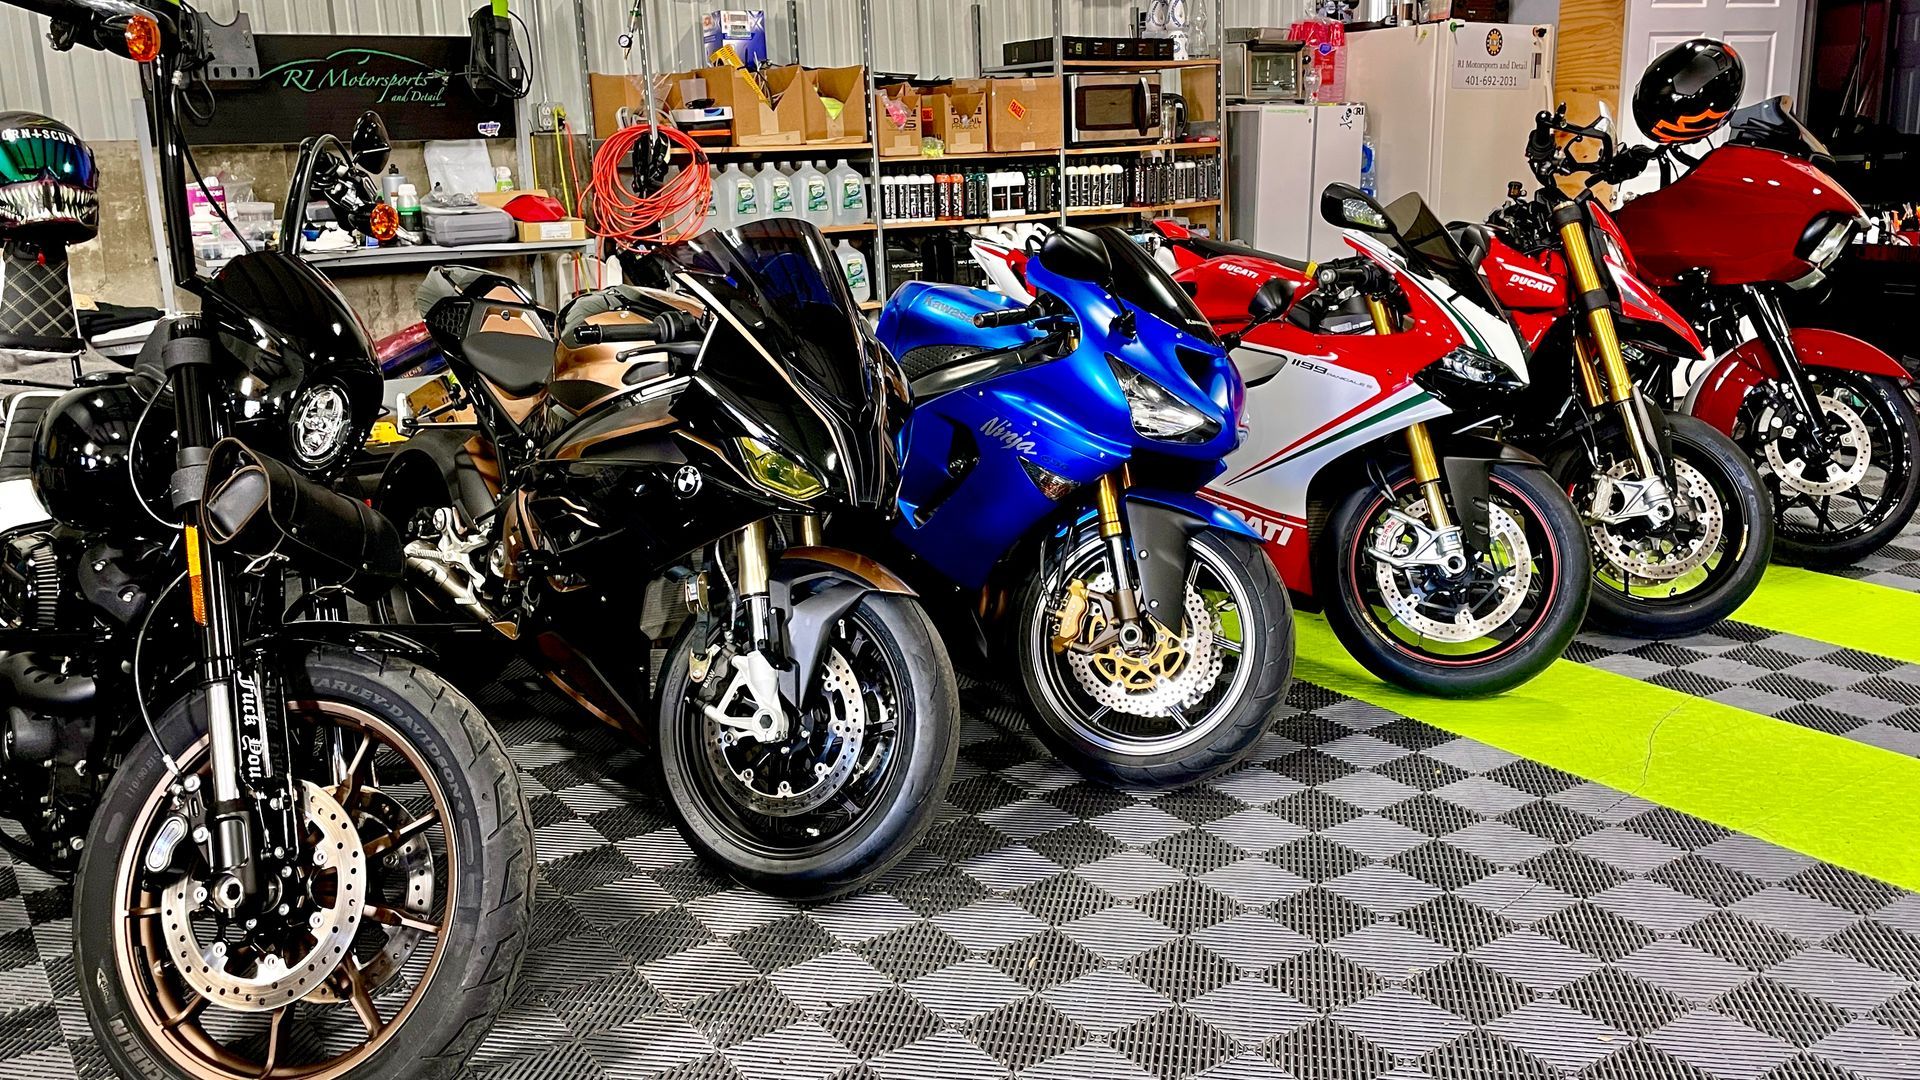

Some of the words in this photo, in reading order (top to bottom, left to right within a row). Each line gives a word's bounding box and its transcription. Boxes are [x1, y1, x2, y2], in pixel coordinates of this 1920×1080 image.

[1457, 60, 1465, 68] RI
[1466, 61, 1498, 71] Motorsports
[1500, 61, 1510, 69] and
[1511, 61, 1528, 69] Detail
[282, 68, 316, 92] RI
[318, 68, 428, 103] Motorsports
[1465, 75, 1517, 86] 401-692-2031
[391, 87, 412, 102] and
[410, 87, 445, 102] Detail
[1218, 263, 1259, 279] DUCATI
[1509, 273, 1554, 293] DUCATI
[922, 295, 974, 322] Kawasa
[1291, 359, 1328, 375] 1199
[980, 416, 1037, 455] Ninja
[1229, 509, 1293, 546] ATI
[703, 669, 716, 689] BMW
[237, 670, 259, 727] Fuck
[109, 1018, 166, 1080] CHELIN
